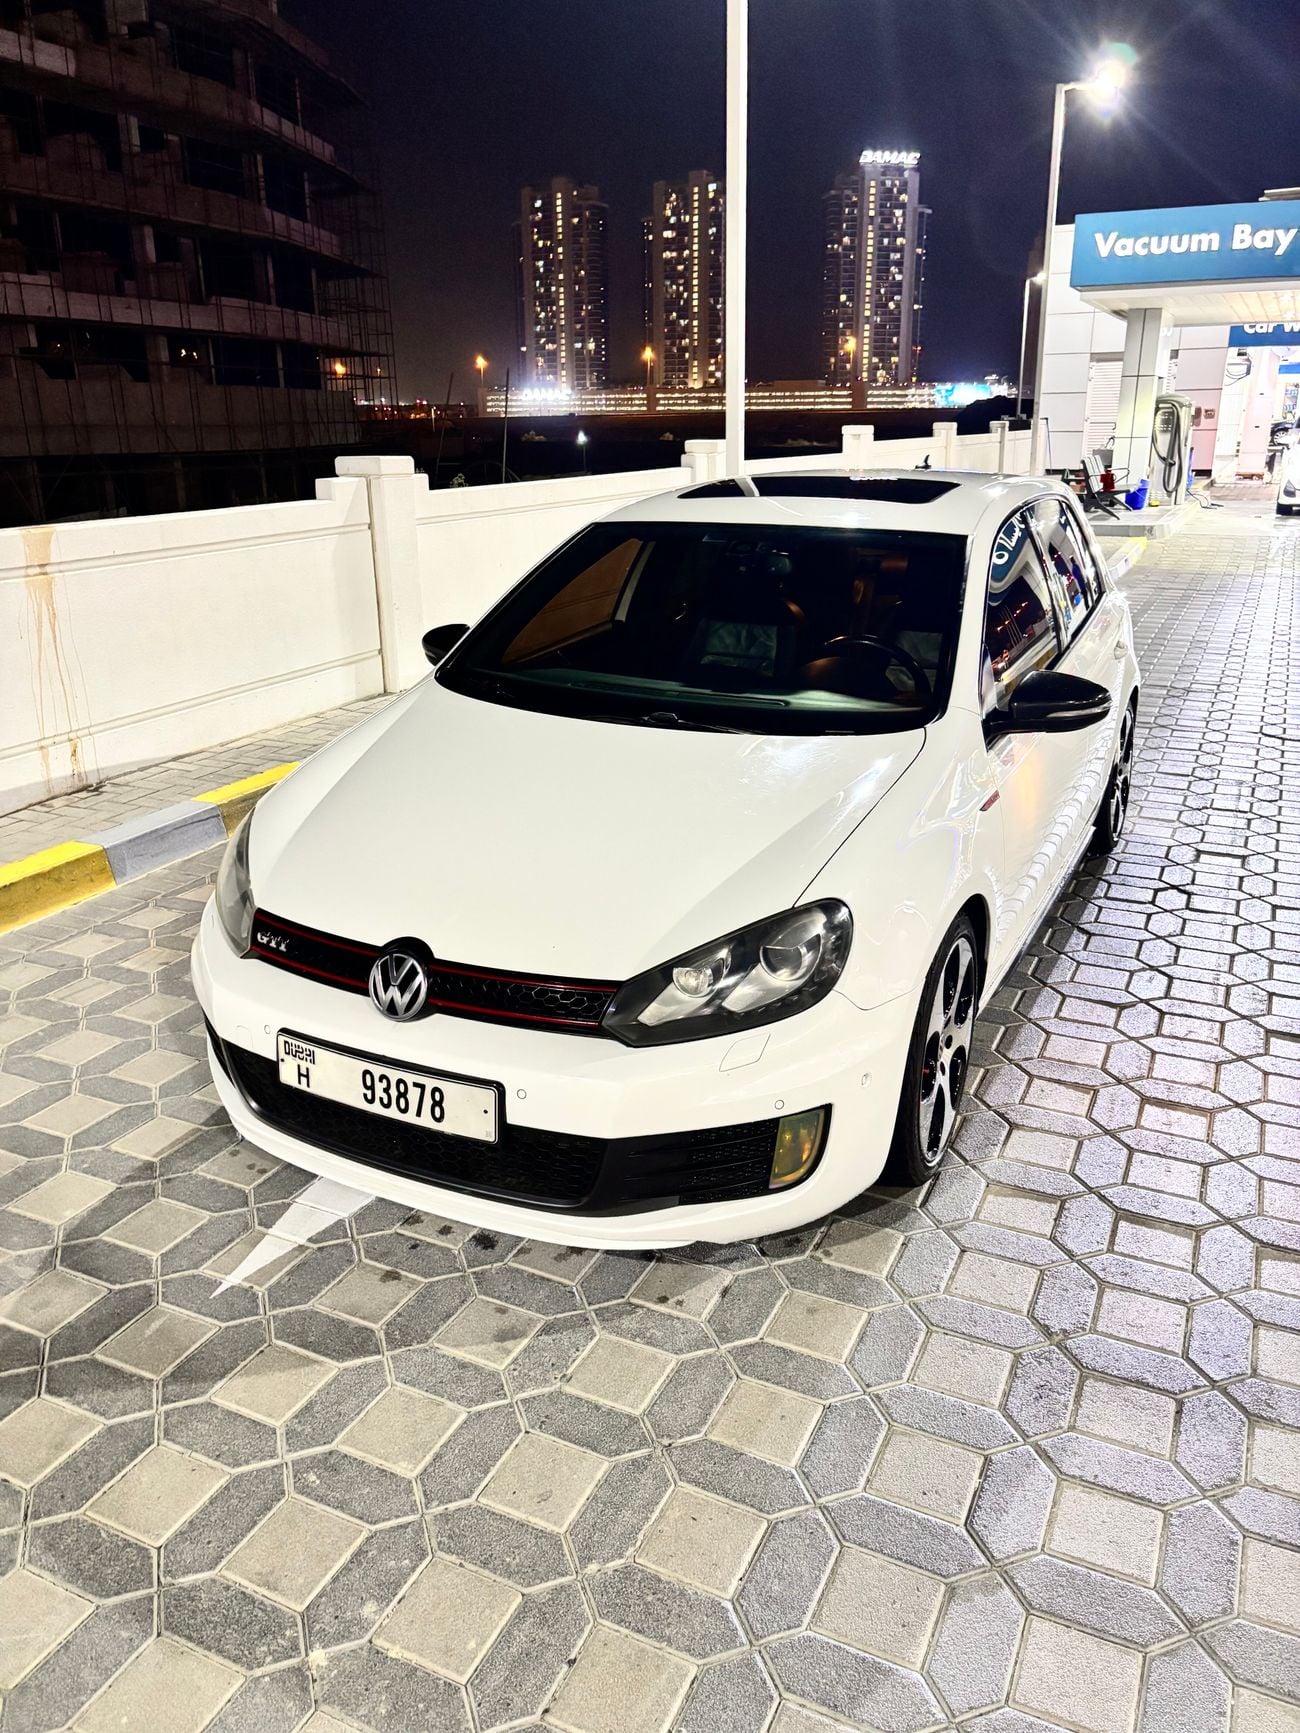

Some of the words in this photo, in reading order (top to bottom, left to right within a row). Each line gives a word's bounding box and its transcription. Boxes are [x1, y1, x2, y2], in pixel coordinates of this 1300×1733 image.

[1094, 232, 1219, 257] Vacuum
[1232, 224, 1297, 255] Bay
[256, 932, 290, 953] GTI
[297, 1064, 311, 1088] H
[362, 1070, 445, 1123] 93878
